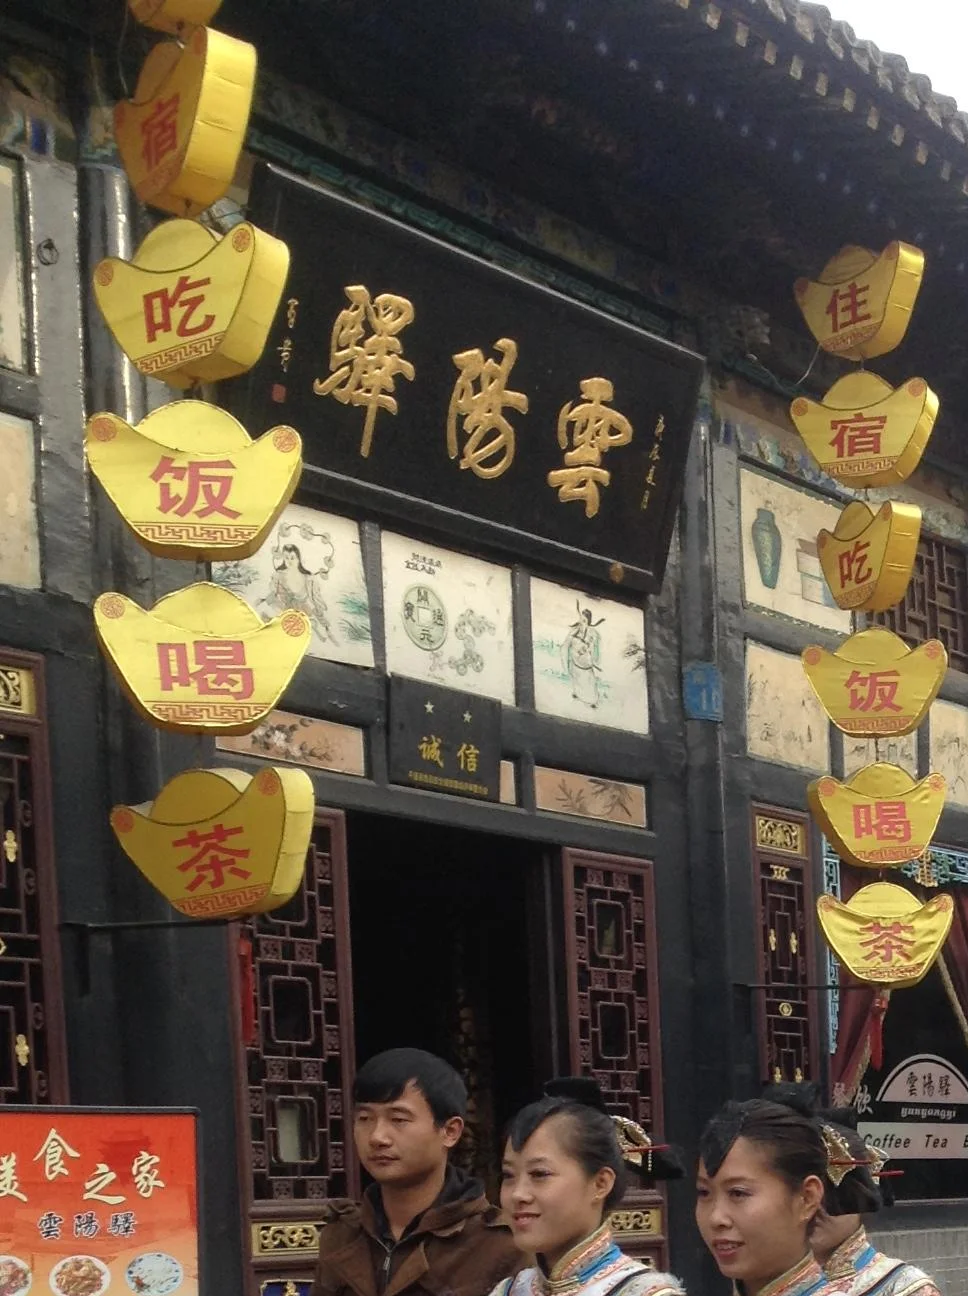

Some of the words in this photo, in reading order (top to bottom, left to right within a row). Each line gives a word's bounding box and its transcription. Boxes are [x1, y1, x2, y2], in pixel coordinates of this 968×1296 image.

[142, 275, 215, 343] 吃
[825, 282, 871, 333] 住
[829, 412, 888, 458] 宿
[149, 455, 243, 520] 饭
[838, 540, 873, 588] 吃
[156, 639, 255, 700] 喝
[844, 669, 904, 713] 饭
[852, 801, 912, 843] 喝
[172, 824, 253, 893] 茶
[859, 921, 916, 963] 茶
[864, 1133, 912, 1149] Coffee
[924, 1134, 948, 1148] Tea
